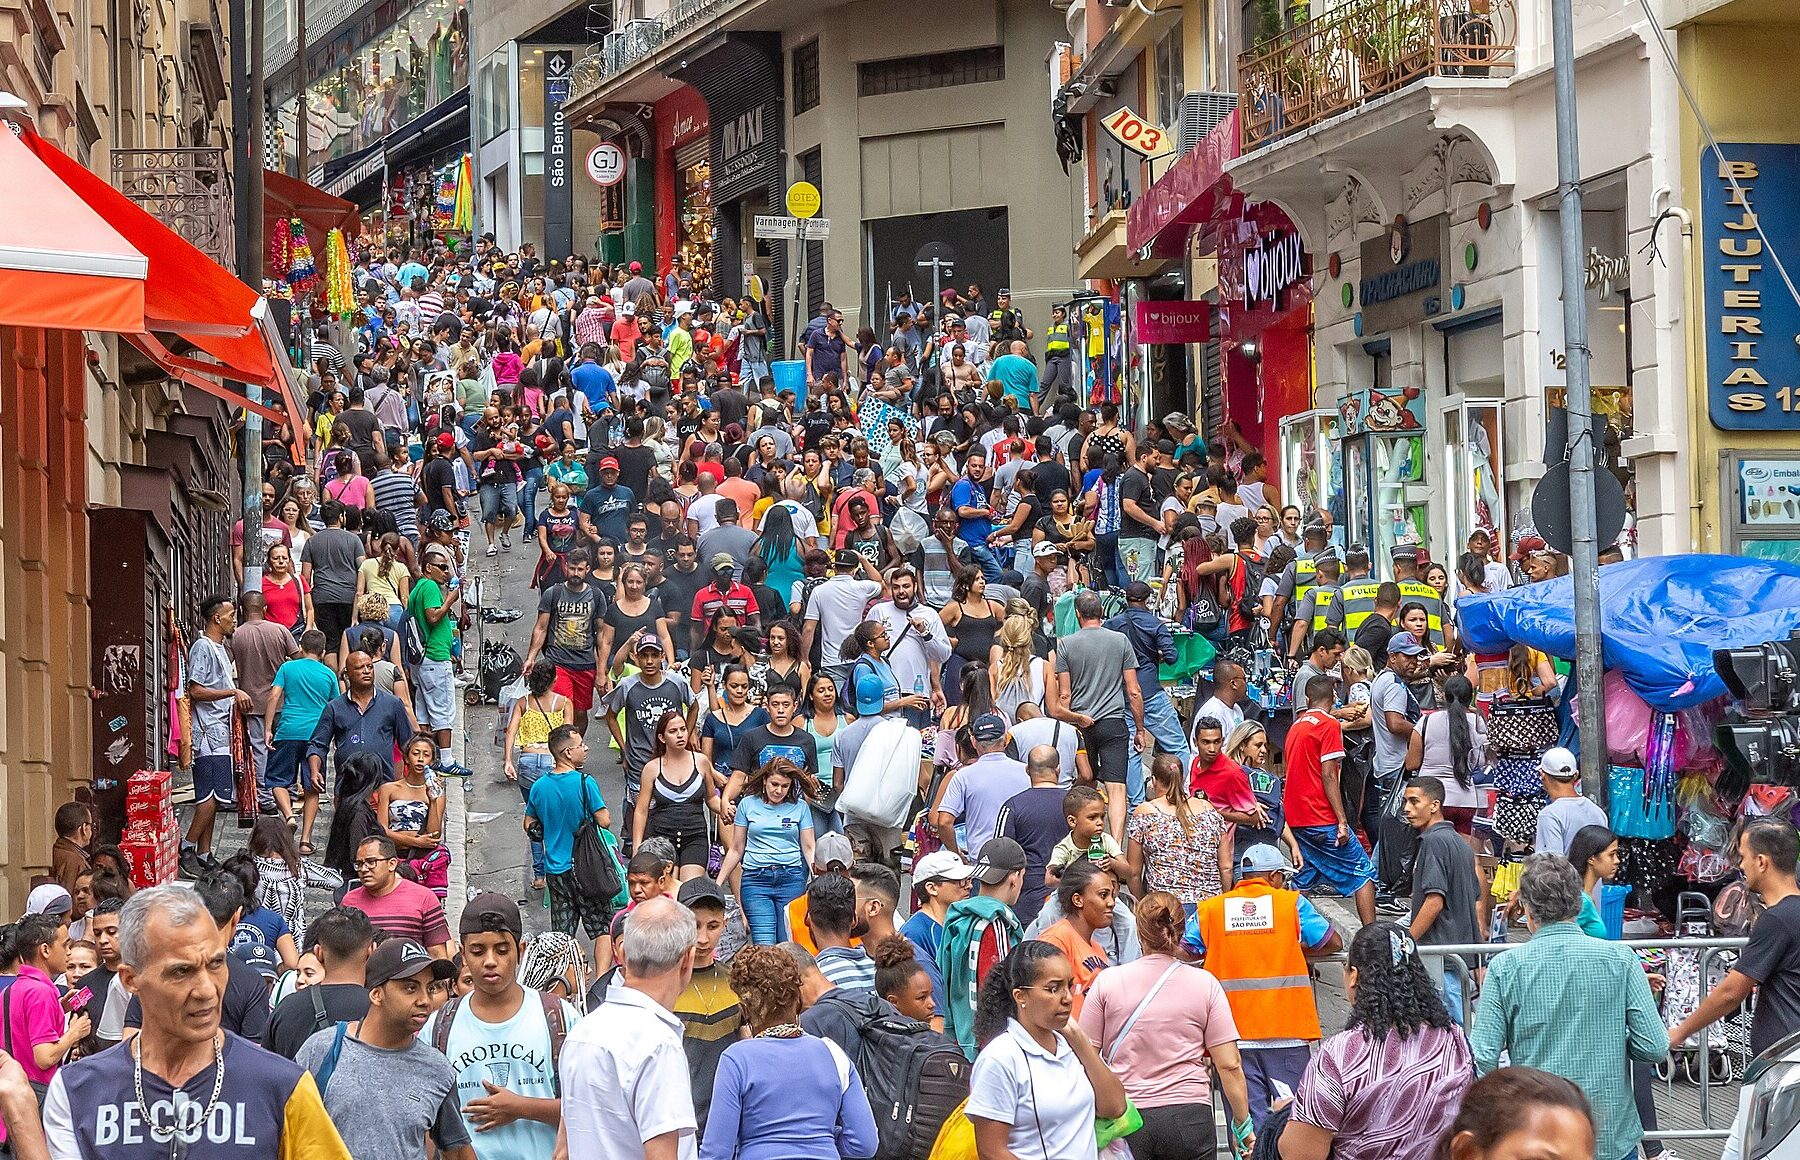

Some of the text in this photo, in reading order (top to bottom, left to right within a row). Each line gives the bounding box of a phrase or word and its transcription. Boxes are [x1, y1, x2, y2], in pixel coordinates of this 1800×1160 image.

[635, 103, 654, 119] 73
[720, 106, 764, 163] MAXI
[1111, 111, 1161, 151] 103
[551, 111, 564, 187] São Bento
[593, 151, 618, 169] GJ
[788, 193, 818, 201] LOTEX
[755, 217, 797, 228] Varnhagen
[1260, 229, 1303, 313] bijoux
[1718, 161, 1768, 411] BIJUTERIAS
[1161, 312, 1200, 328] bijoux
[559, 601, 590, 613] BEER
[452, 1043, 545, 1073] TROPICAL
